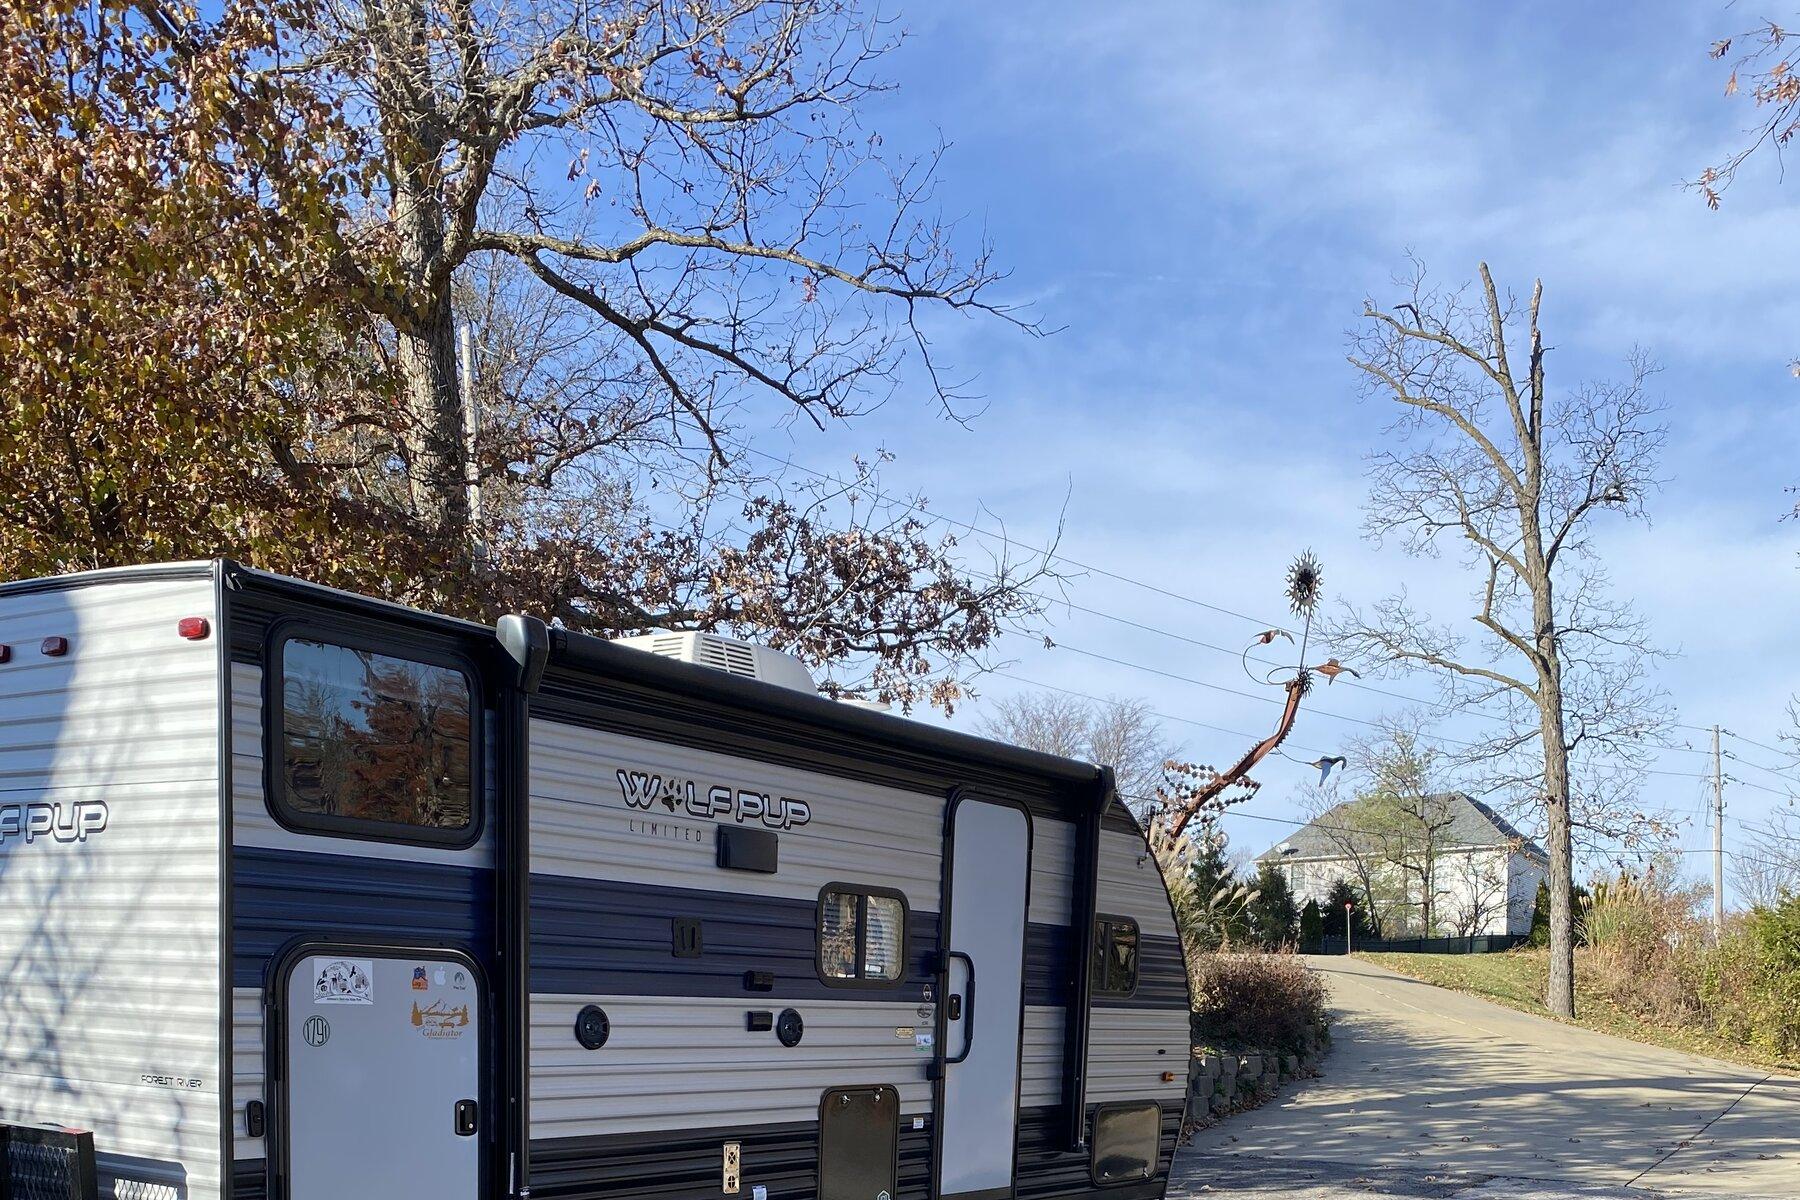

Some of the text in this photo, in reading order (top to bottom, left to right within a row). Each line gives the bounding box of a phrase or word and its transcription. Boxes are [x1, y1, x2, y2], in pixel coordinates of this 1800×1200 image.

[736, 790, 811, 830] PUP
[629, 819, 702, 842] LIMITED
[422, 1028, 463, 1037] Gladiator
[141, 1075, 203, 1088] FOREST RIVER
